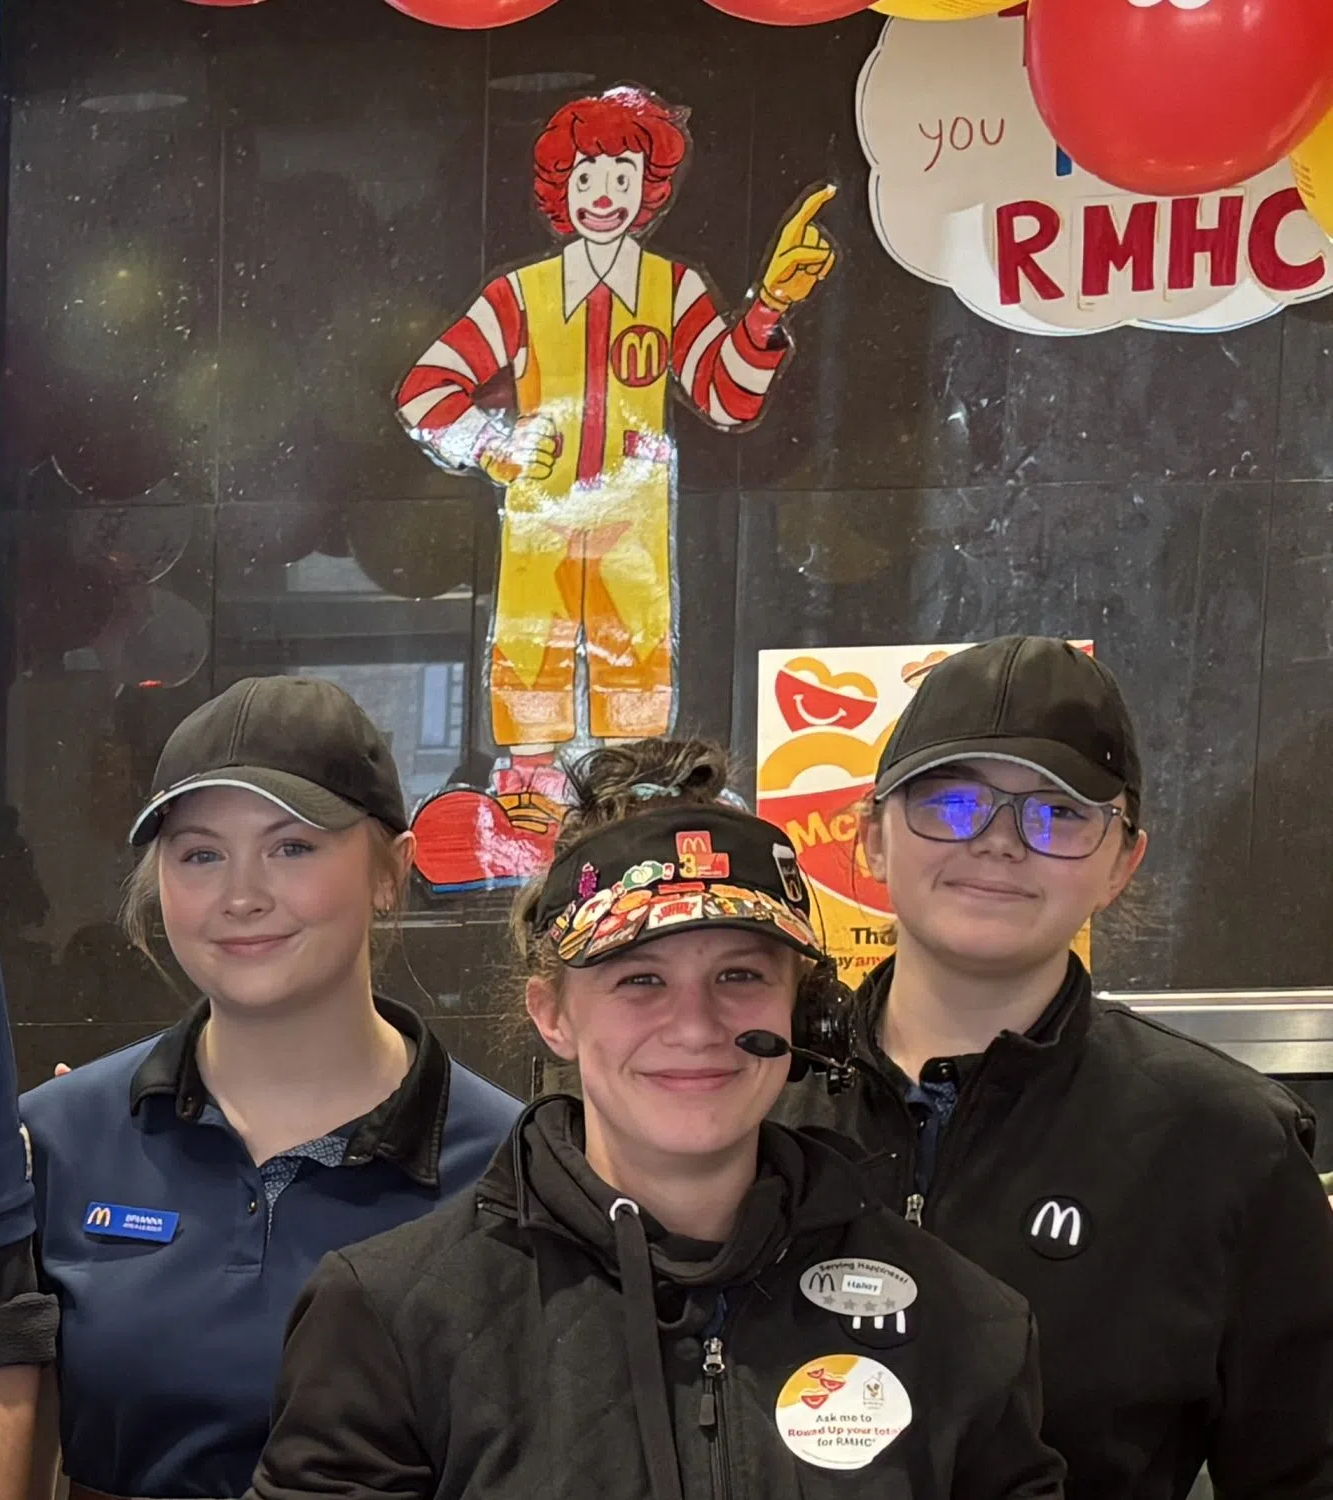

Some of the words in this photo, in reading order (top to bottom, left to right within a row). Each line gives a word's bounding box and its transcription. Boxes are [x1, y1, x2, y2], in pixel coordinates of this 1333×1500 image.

[996, 187, 1325, 305] RMHC
[816, 1414, 837, 1423] Ask
[861, 1414, 872, 1422] to
[788, 1427, 825, 1437] Round
[828, 1427, 844, 1435] Up
[817, 1437, 833, 1447] for
